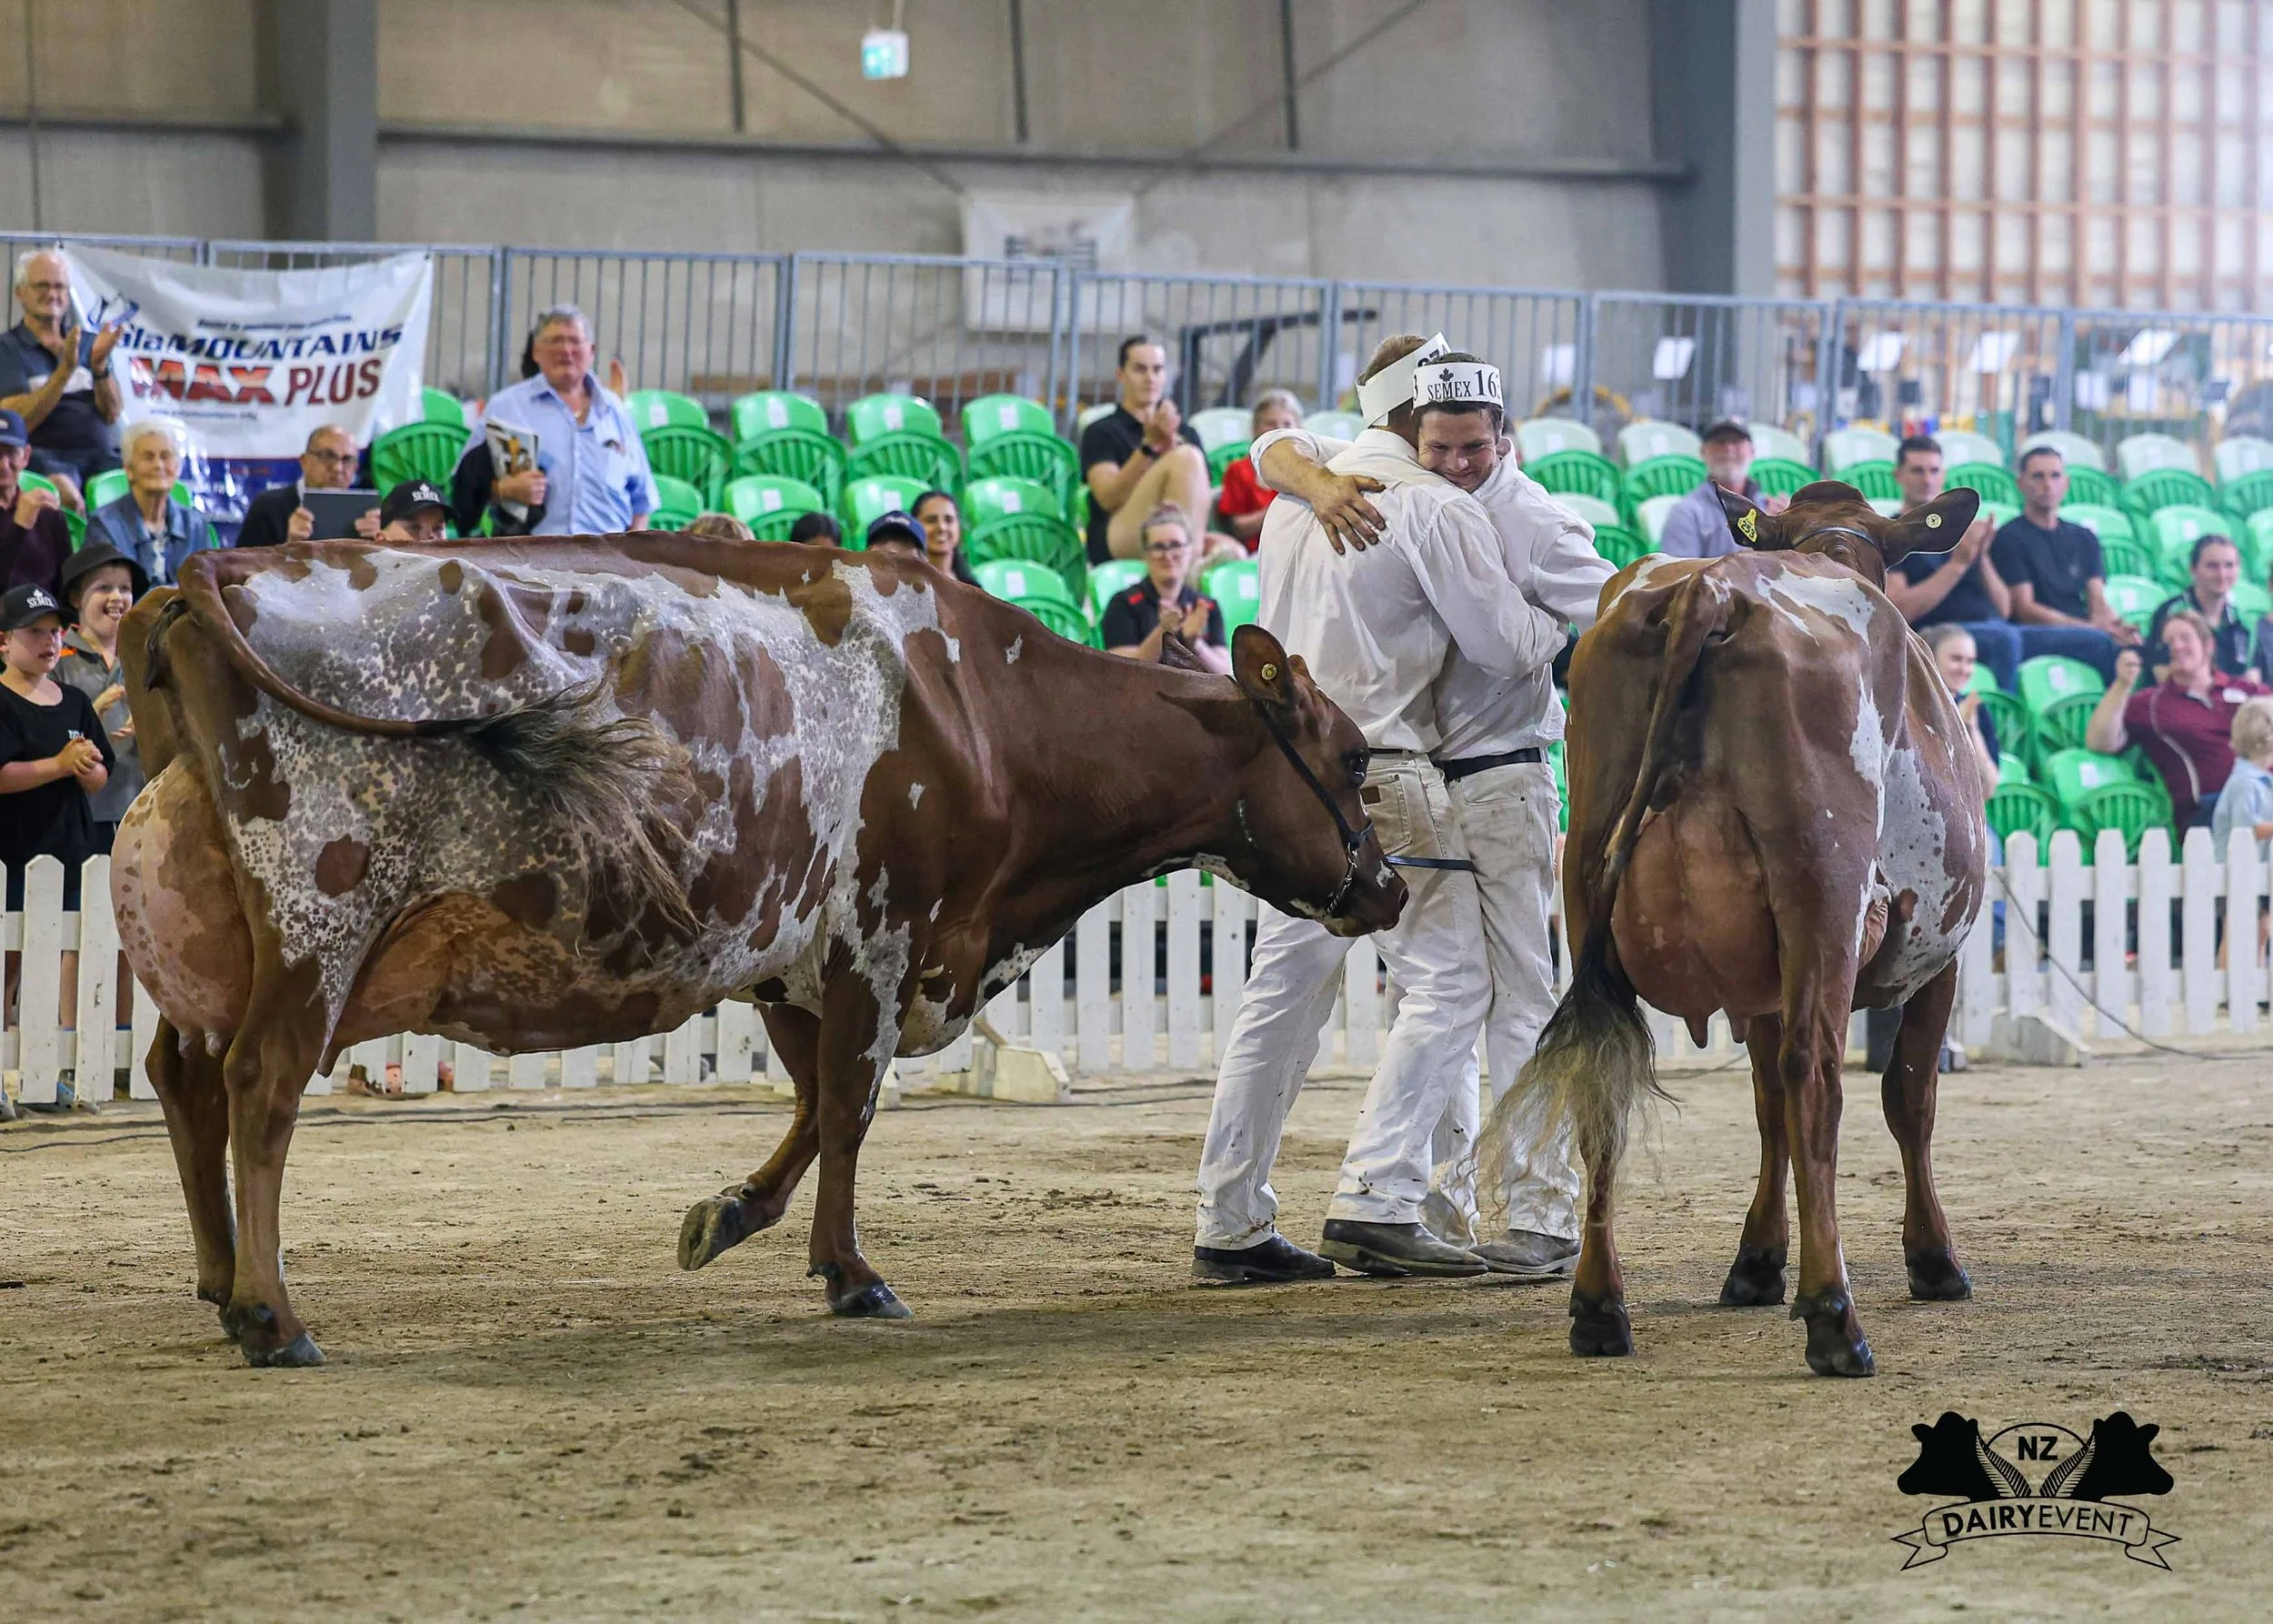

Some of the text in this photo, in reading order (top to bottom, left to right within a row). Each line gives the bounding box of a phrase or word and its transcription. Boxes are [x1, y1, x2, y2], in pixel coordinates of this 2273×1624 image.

[118, 324, 402, 360] alaMOUNTAINS
[129, 356, 382, 406] MAX PLUS
[1427, 381, 1472, 400] SEMEX
[1740, 520, 1755, 538] 253
